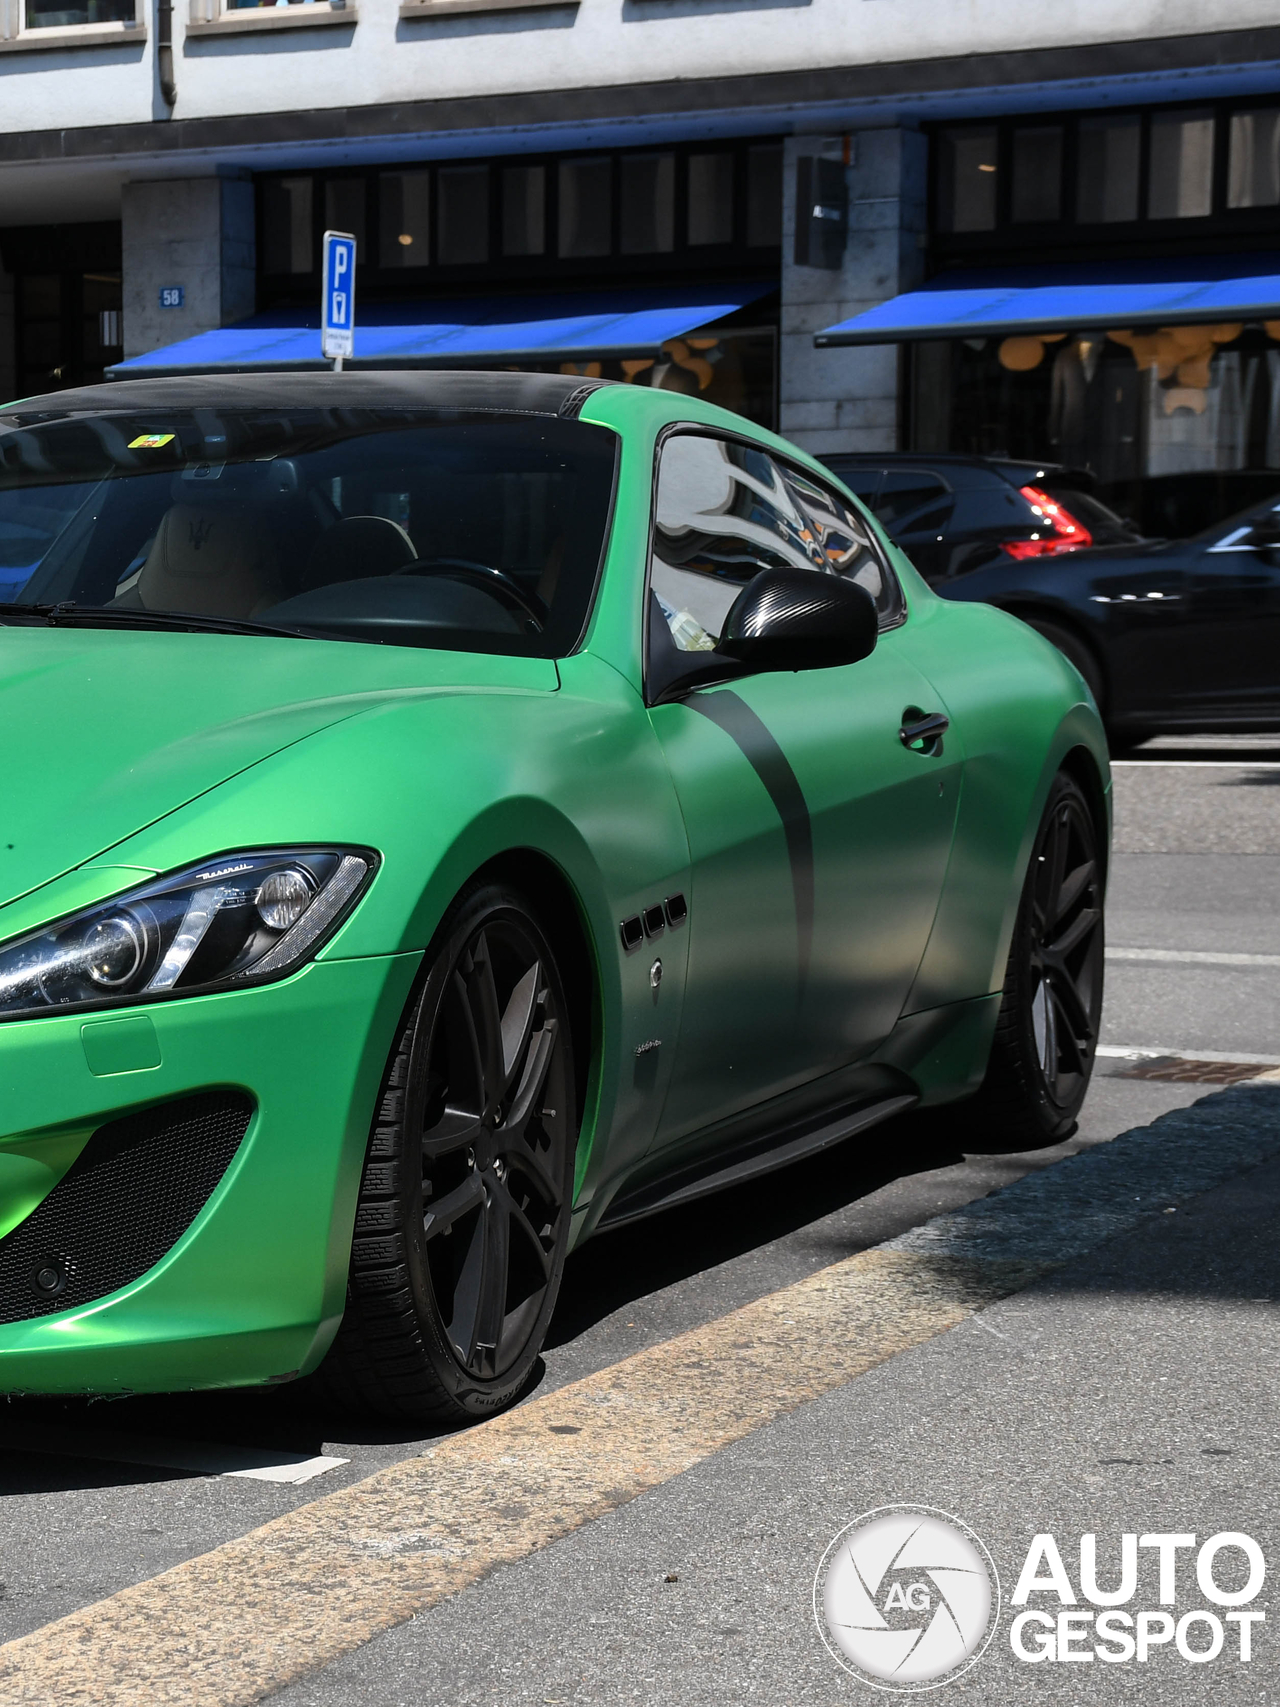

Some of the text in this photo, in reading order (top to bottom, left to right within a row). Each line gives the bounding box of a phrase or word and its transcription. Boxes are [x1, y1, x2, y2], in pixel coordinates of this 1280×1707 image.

[334, 245, 348, 289] P
[163, 289, 180, 306] 58
[196, 864, 254, 880] Maserati
